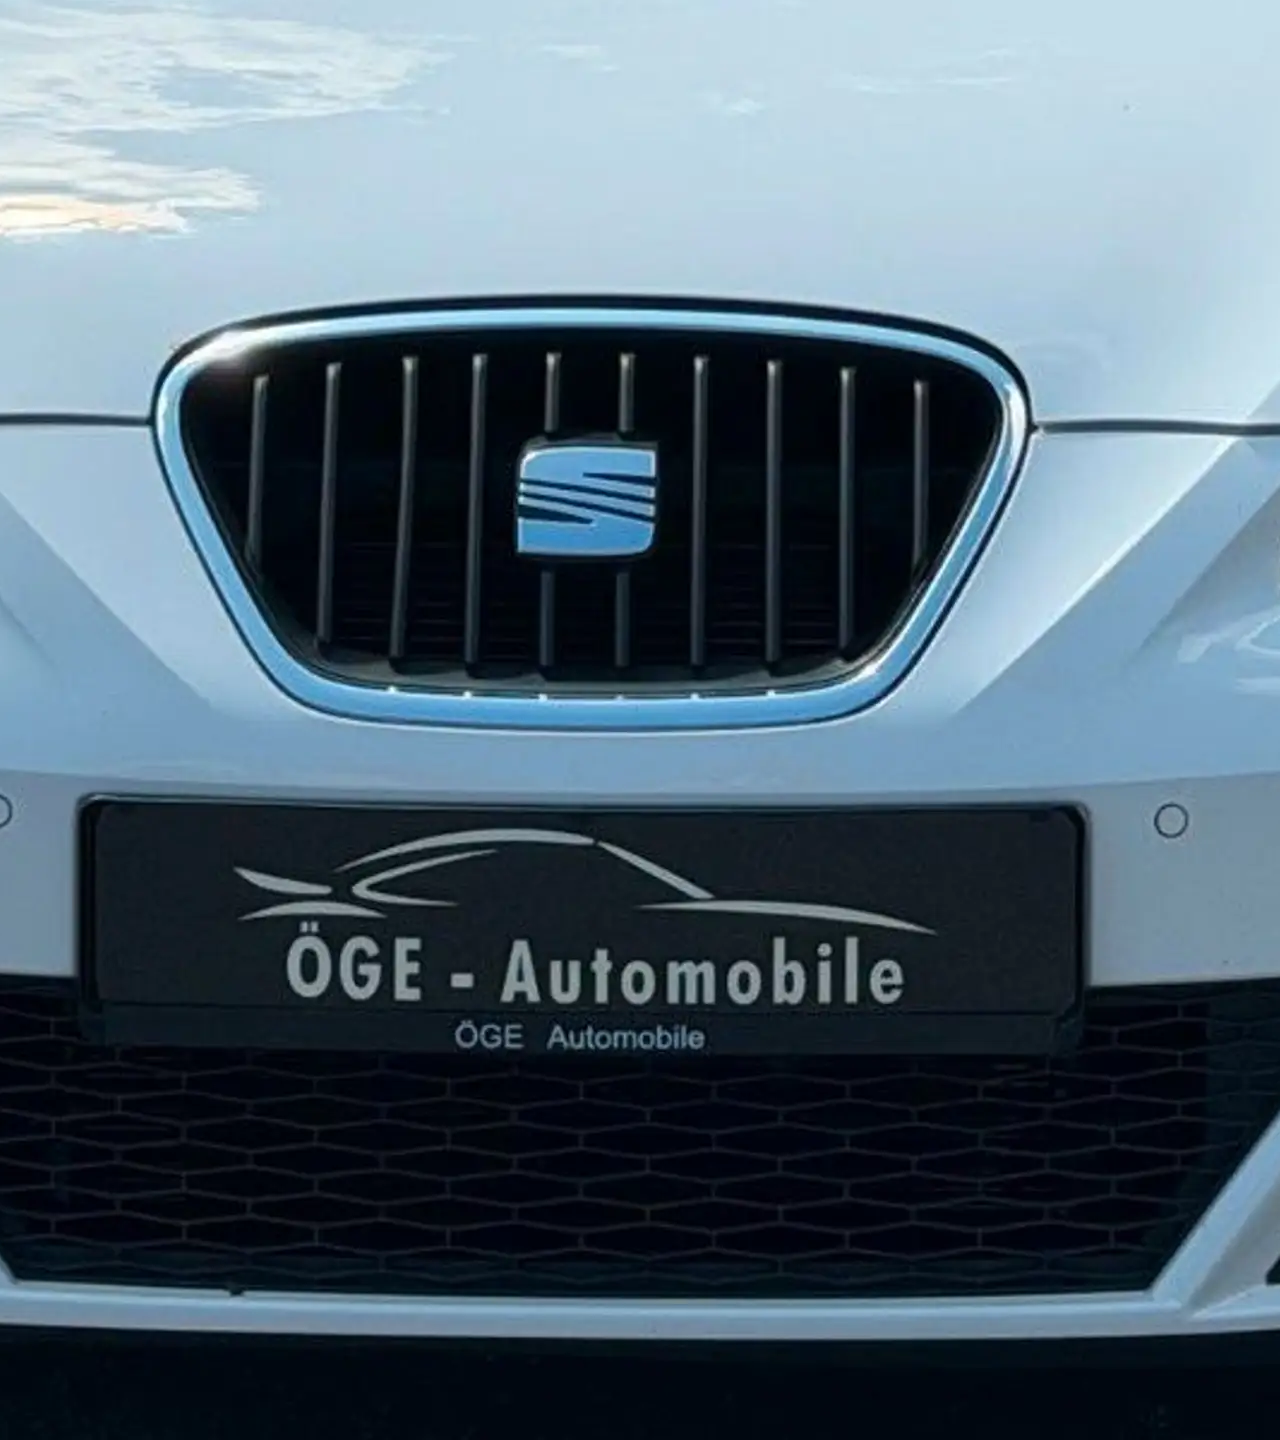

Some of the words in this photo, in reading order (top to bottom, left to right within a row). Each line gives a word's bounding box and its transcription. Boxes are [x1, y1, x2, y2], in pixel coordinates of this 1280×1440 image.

[286, 922, 422, 1003] ÖGE
[500, 936, 904, 1006] Automobile
[454, 1019, 525, 1051] ÖGE
[546, 1024, 706, 1051] Automobile
